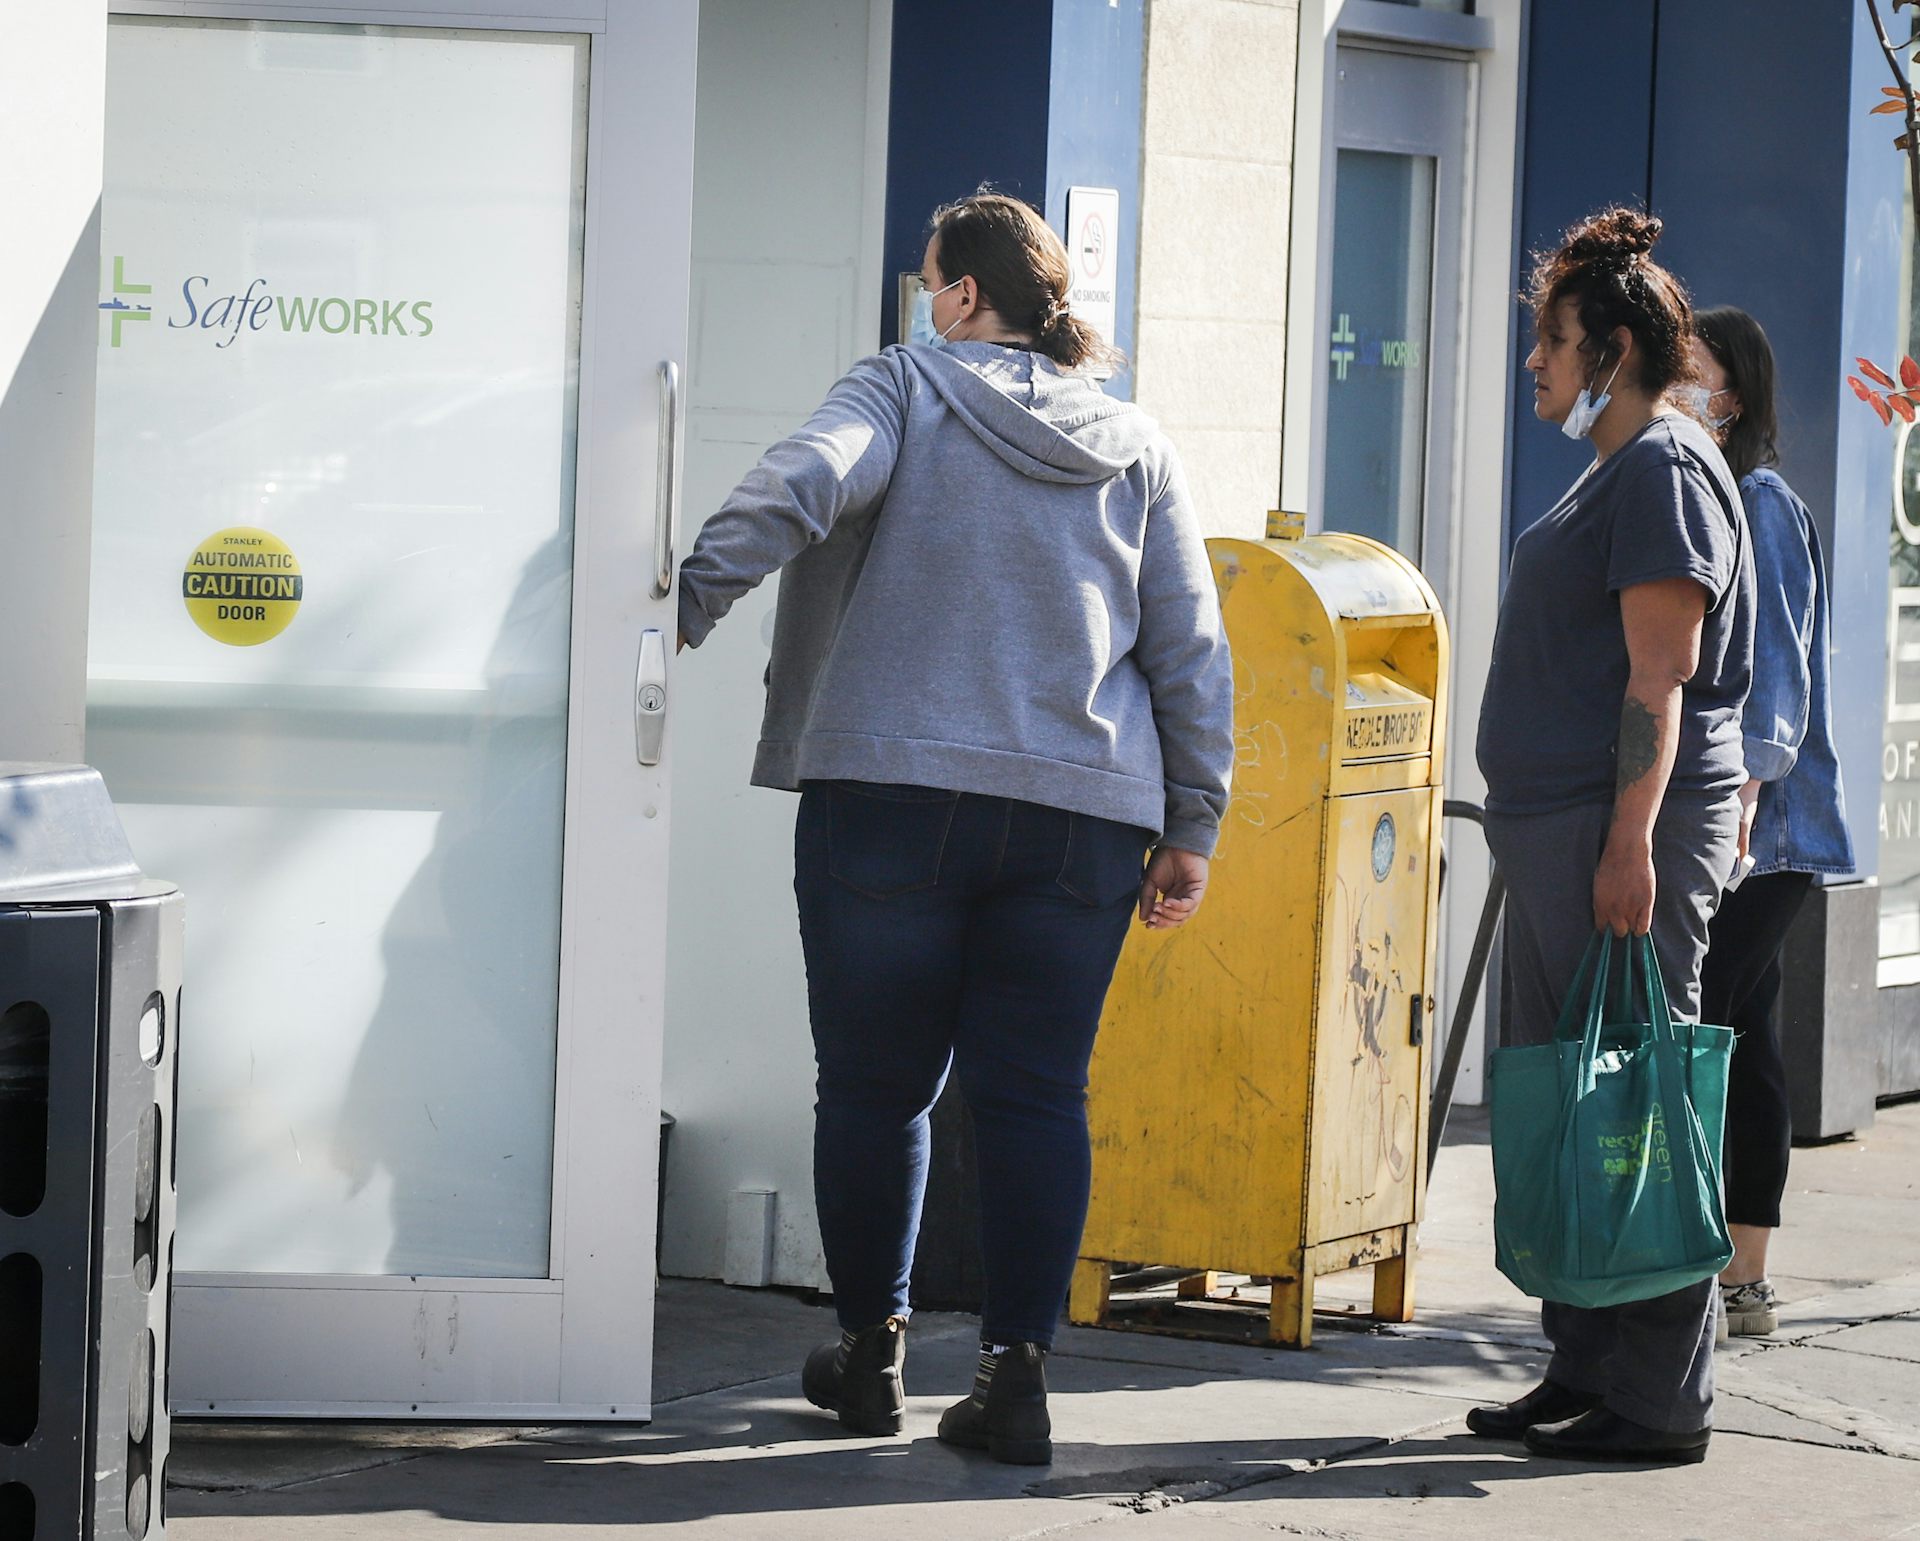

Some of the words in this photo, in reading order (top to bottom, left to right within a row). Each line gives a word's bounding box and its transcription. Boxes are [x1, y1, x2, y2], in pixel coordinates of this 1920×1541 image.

[1072, 288, 1082, 302] NO
[1083, 289, 1111, 303] SMOKING
[223, 537, 264, 546] STANLEY
[193, 551, 293, 569] AUTOMATIC
[186, 574, 295, 598] CAUTION
[217, 604, 266, 621] DOOR
[1383, 712, 1408, 746] DROP
